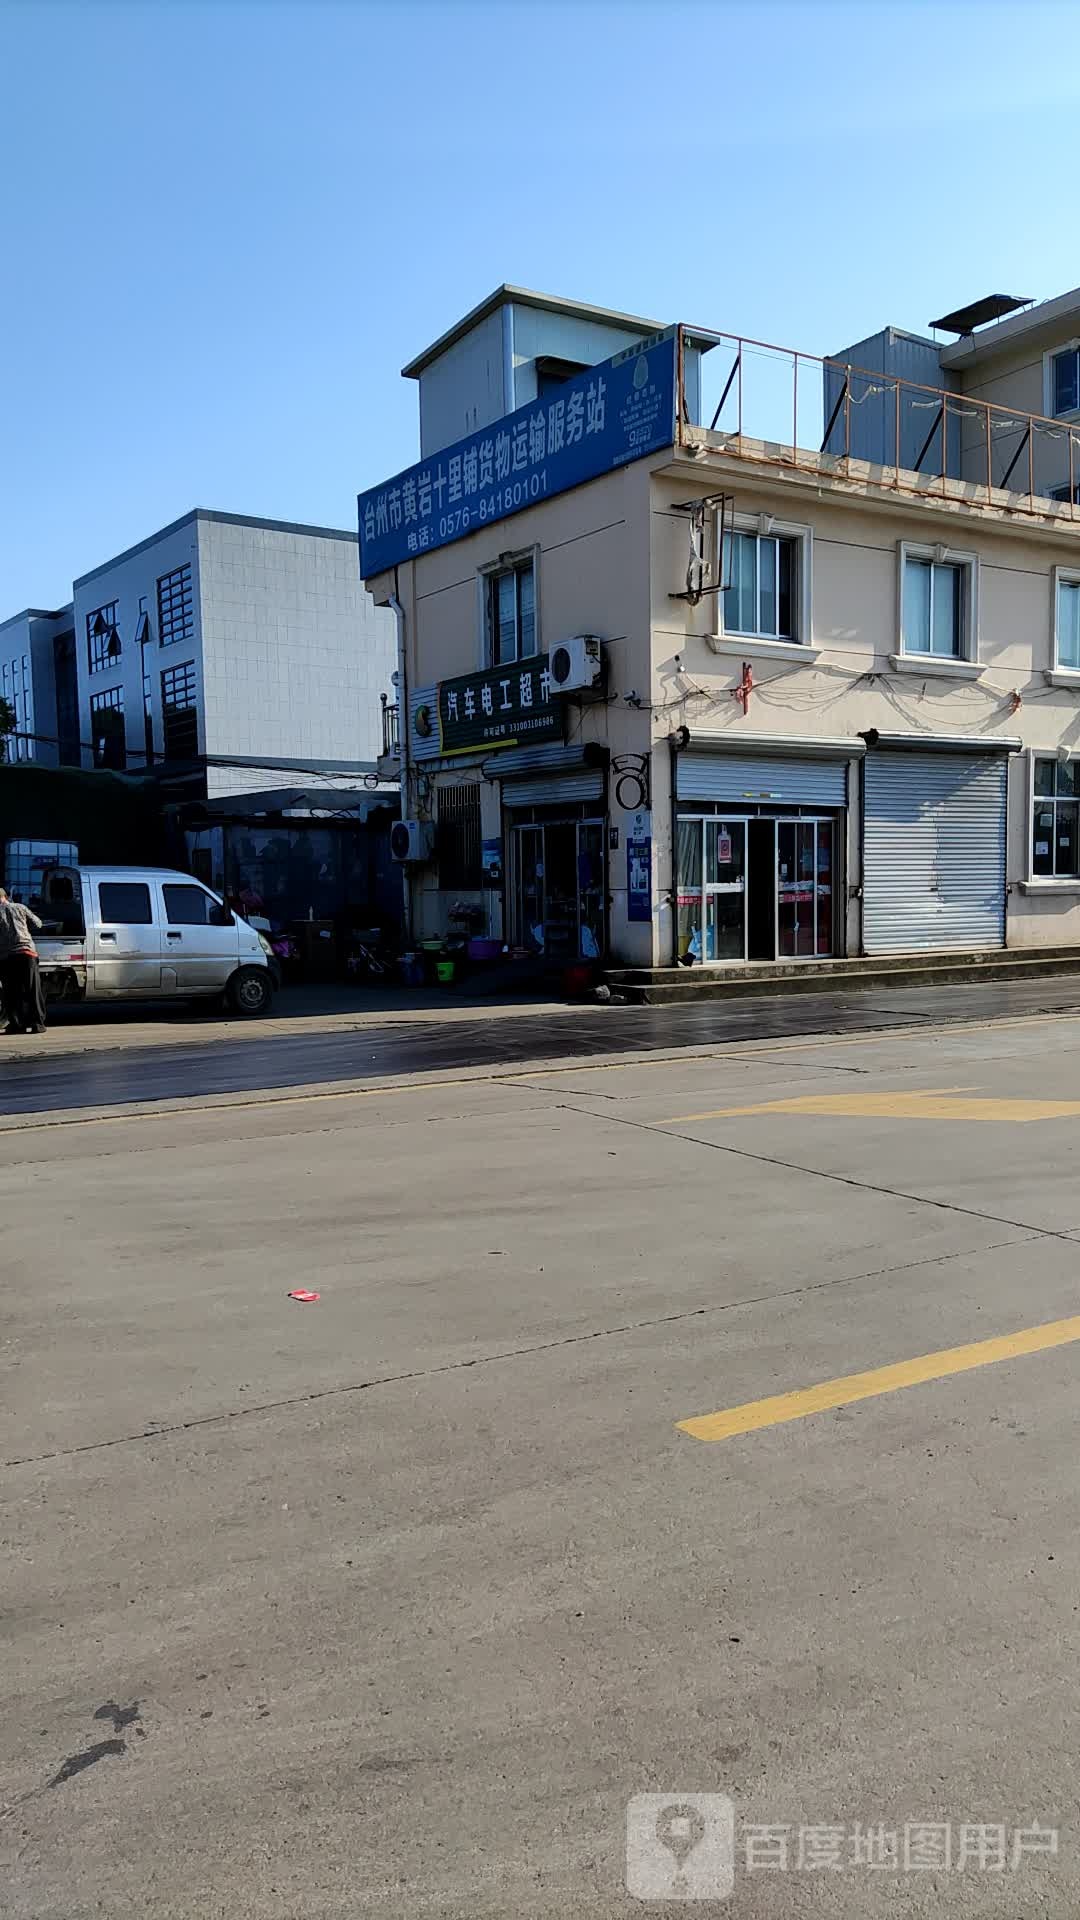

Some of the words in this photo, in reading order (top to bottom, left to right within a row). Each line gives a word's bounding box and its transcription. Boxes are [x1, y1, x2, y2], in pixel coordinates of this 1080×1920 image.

[363, 376, 607, 542] 台州市黄岩十里铺货物运输服务站
